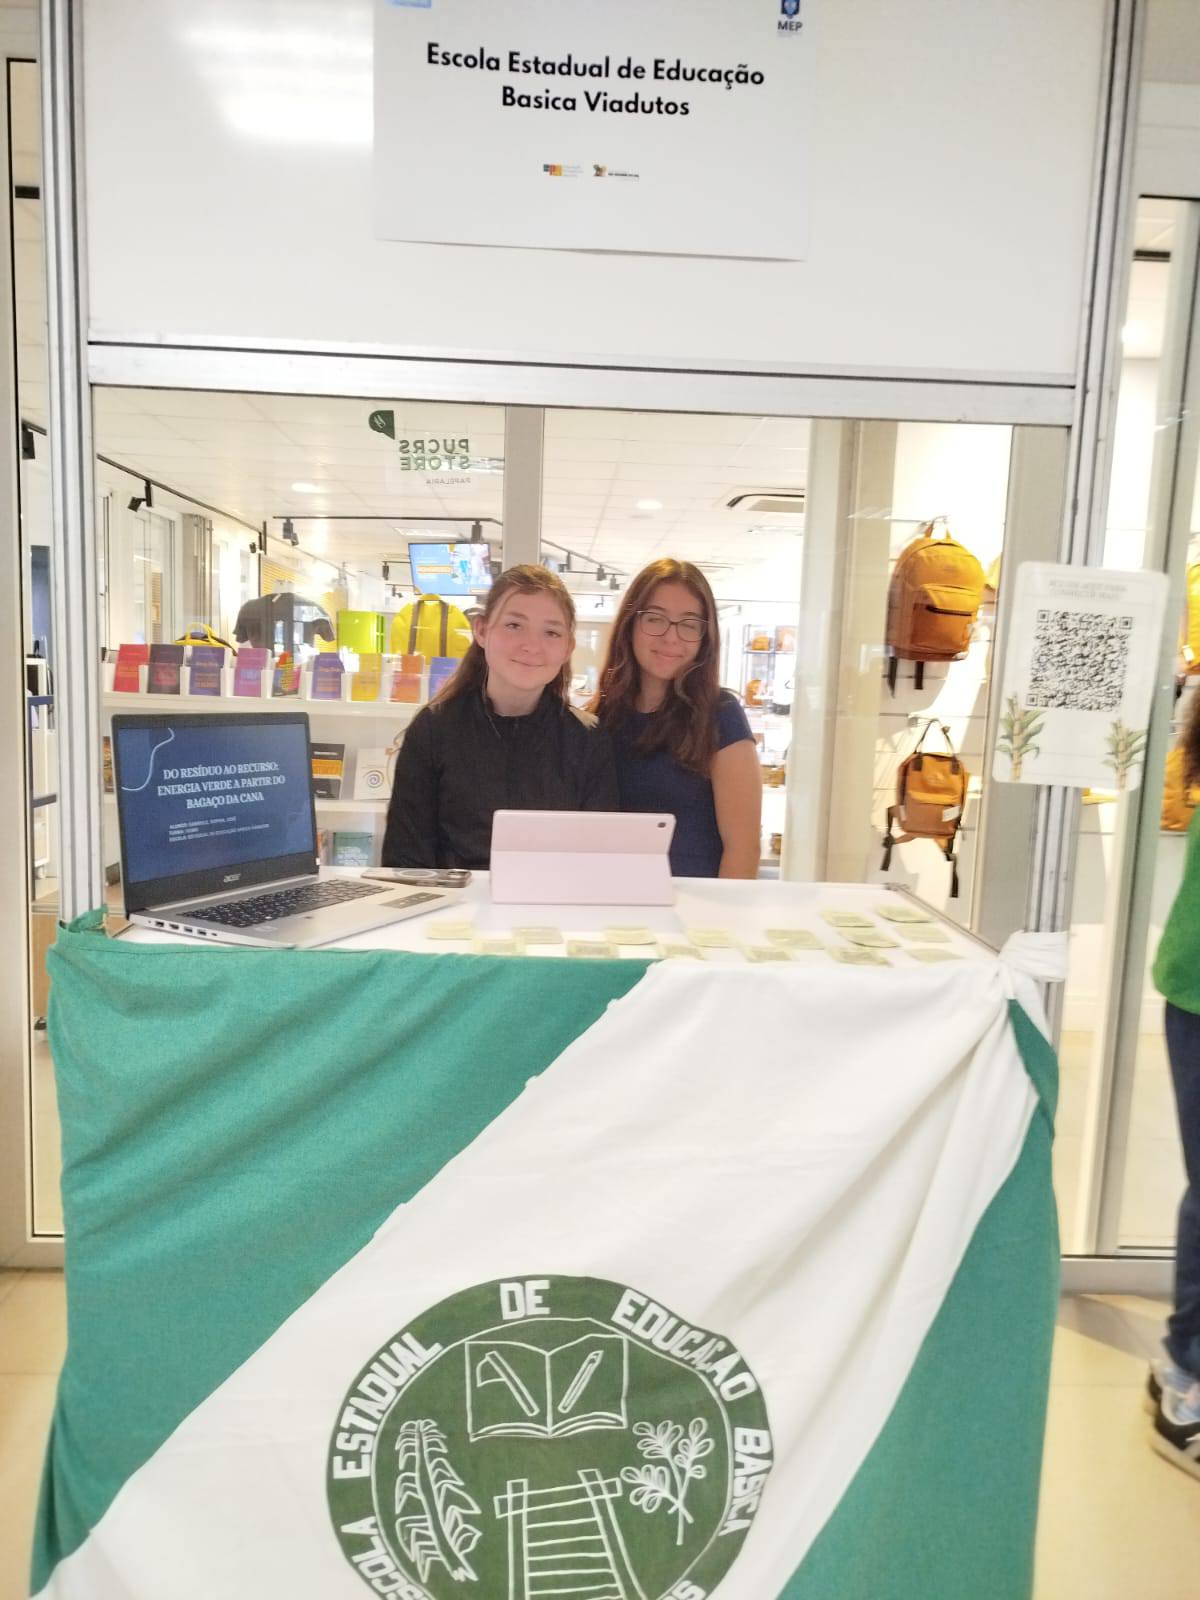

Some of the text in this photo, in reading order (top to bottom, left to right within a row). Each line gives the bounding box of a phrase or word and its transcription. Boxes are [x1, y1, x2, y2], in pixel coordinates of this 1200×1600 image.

[777, 20, 804, 32] MEP
[426, 41, 765, 90] Escola Estadual de Educação
[502, 85, 690, 116] Basica Viadutos
[163, 768, 180, 780] DO
[180, 764, 223, 779] RESÍDUO
[223, 764, 237, 775] AO
[157, 774, 286, 797] ENERGIA VERDE A PARTIR DO
[186, 791, 265, 809] BAGAÇO DA CANA
[332, 1331, 444, 1480] ESTADUAL
[500, 1279, 551, 1320] DE
[717, 1426, 775, 1537] BASICA
